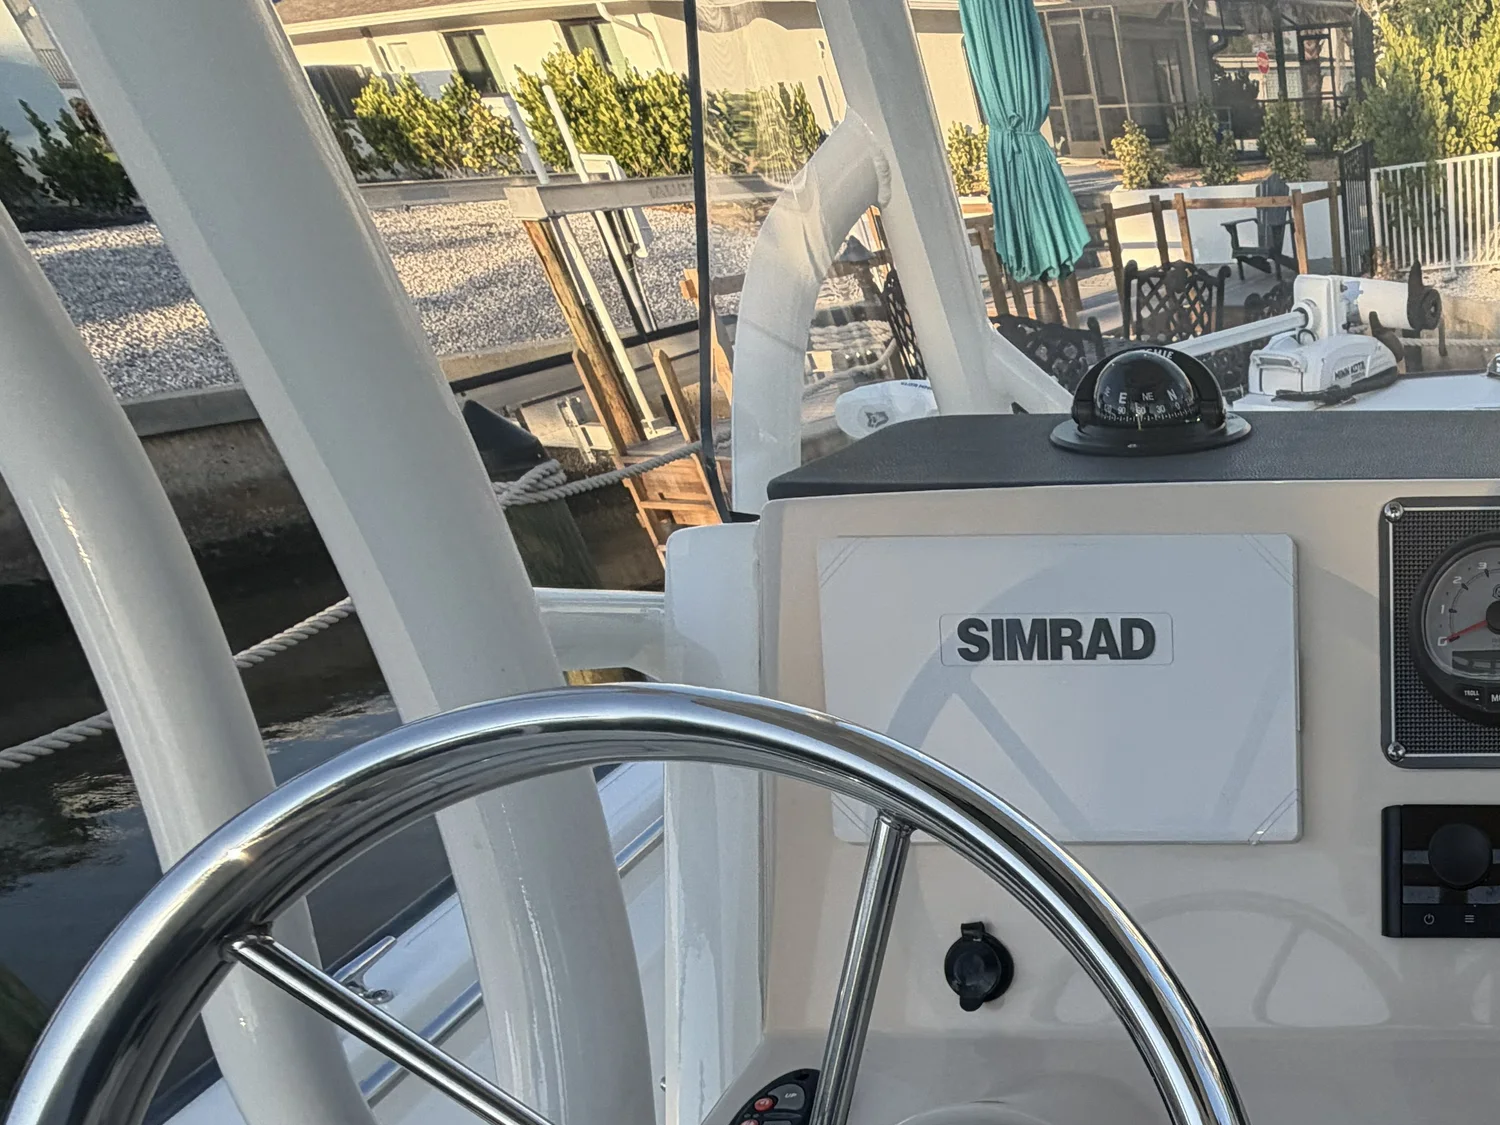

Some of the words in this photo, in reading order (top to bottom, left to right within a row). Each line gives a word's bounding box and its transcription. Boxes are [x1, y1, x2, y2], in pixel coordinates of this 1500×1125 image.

[1142, 392, 1155, 401] NE
[1167, 388, 1178, 401] N
[1453, 576, 1462, 584] 2
[1440, 604, 1445, 614] 1
[957, 617, 1156, 662] SIMRAD
[1437, 636, 1447, 646] 0
